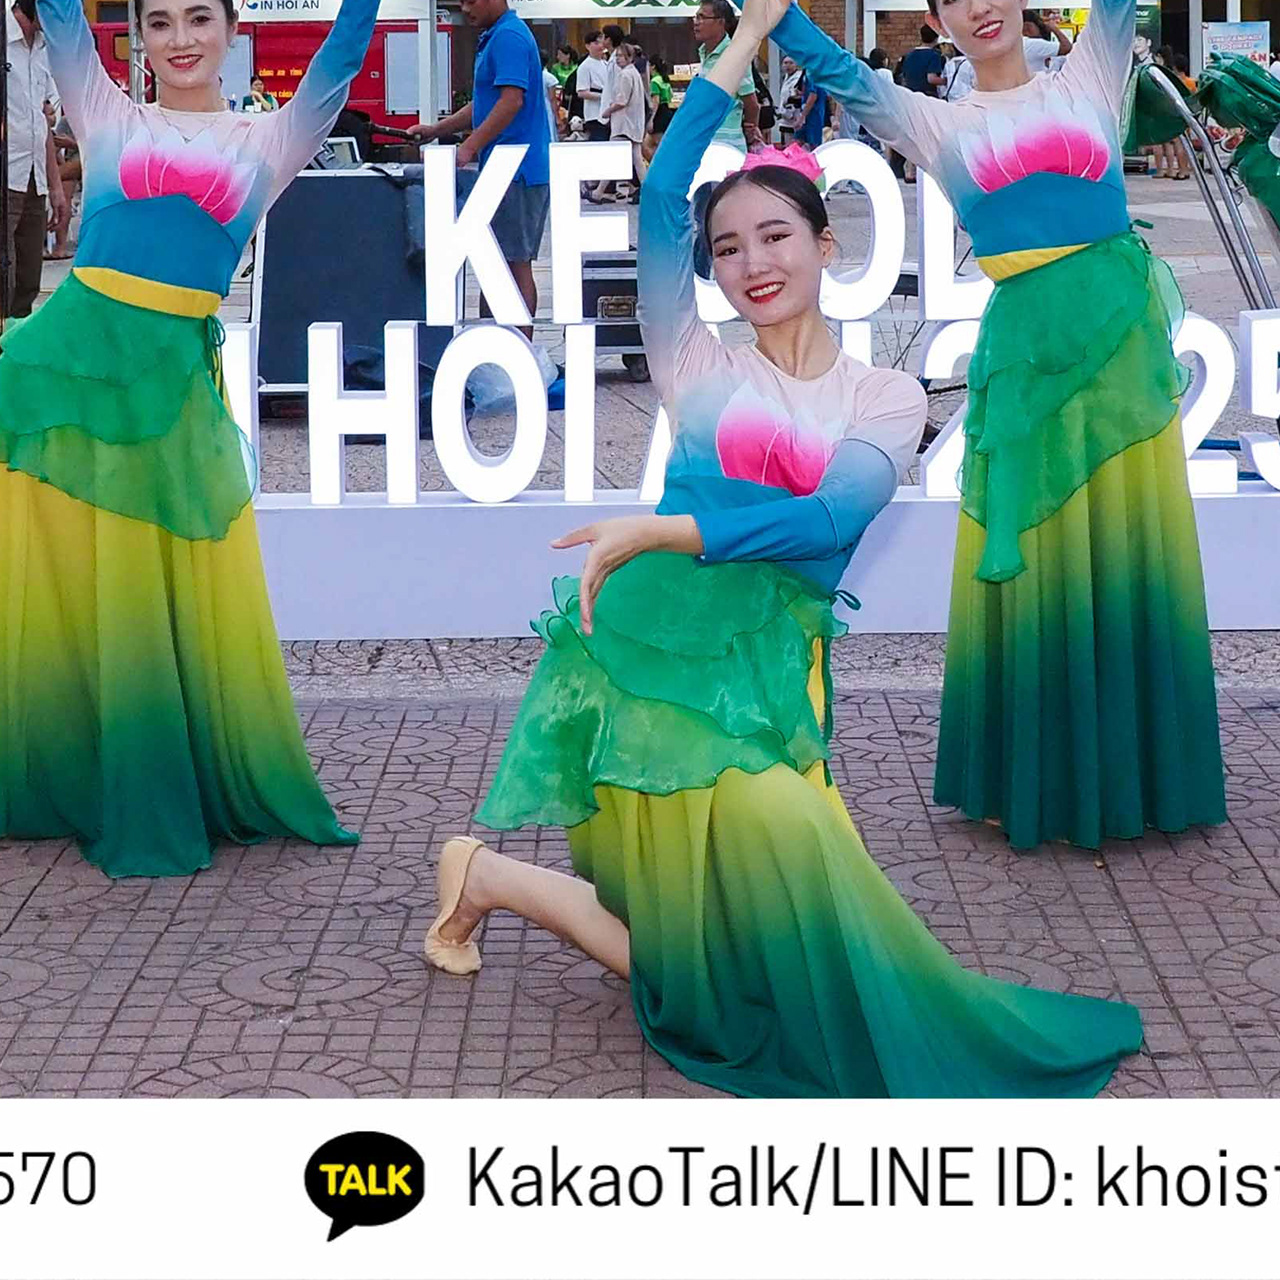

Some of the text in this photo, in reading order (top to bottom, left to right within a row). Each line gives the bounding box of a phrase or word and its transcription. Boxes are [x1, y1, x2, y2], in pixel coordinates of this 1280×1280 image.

[260, 0, 320, 10] IN HOI AN
[308, 320, 596, 506] HOI
